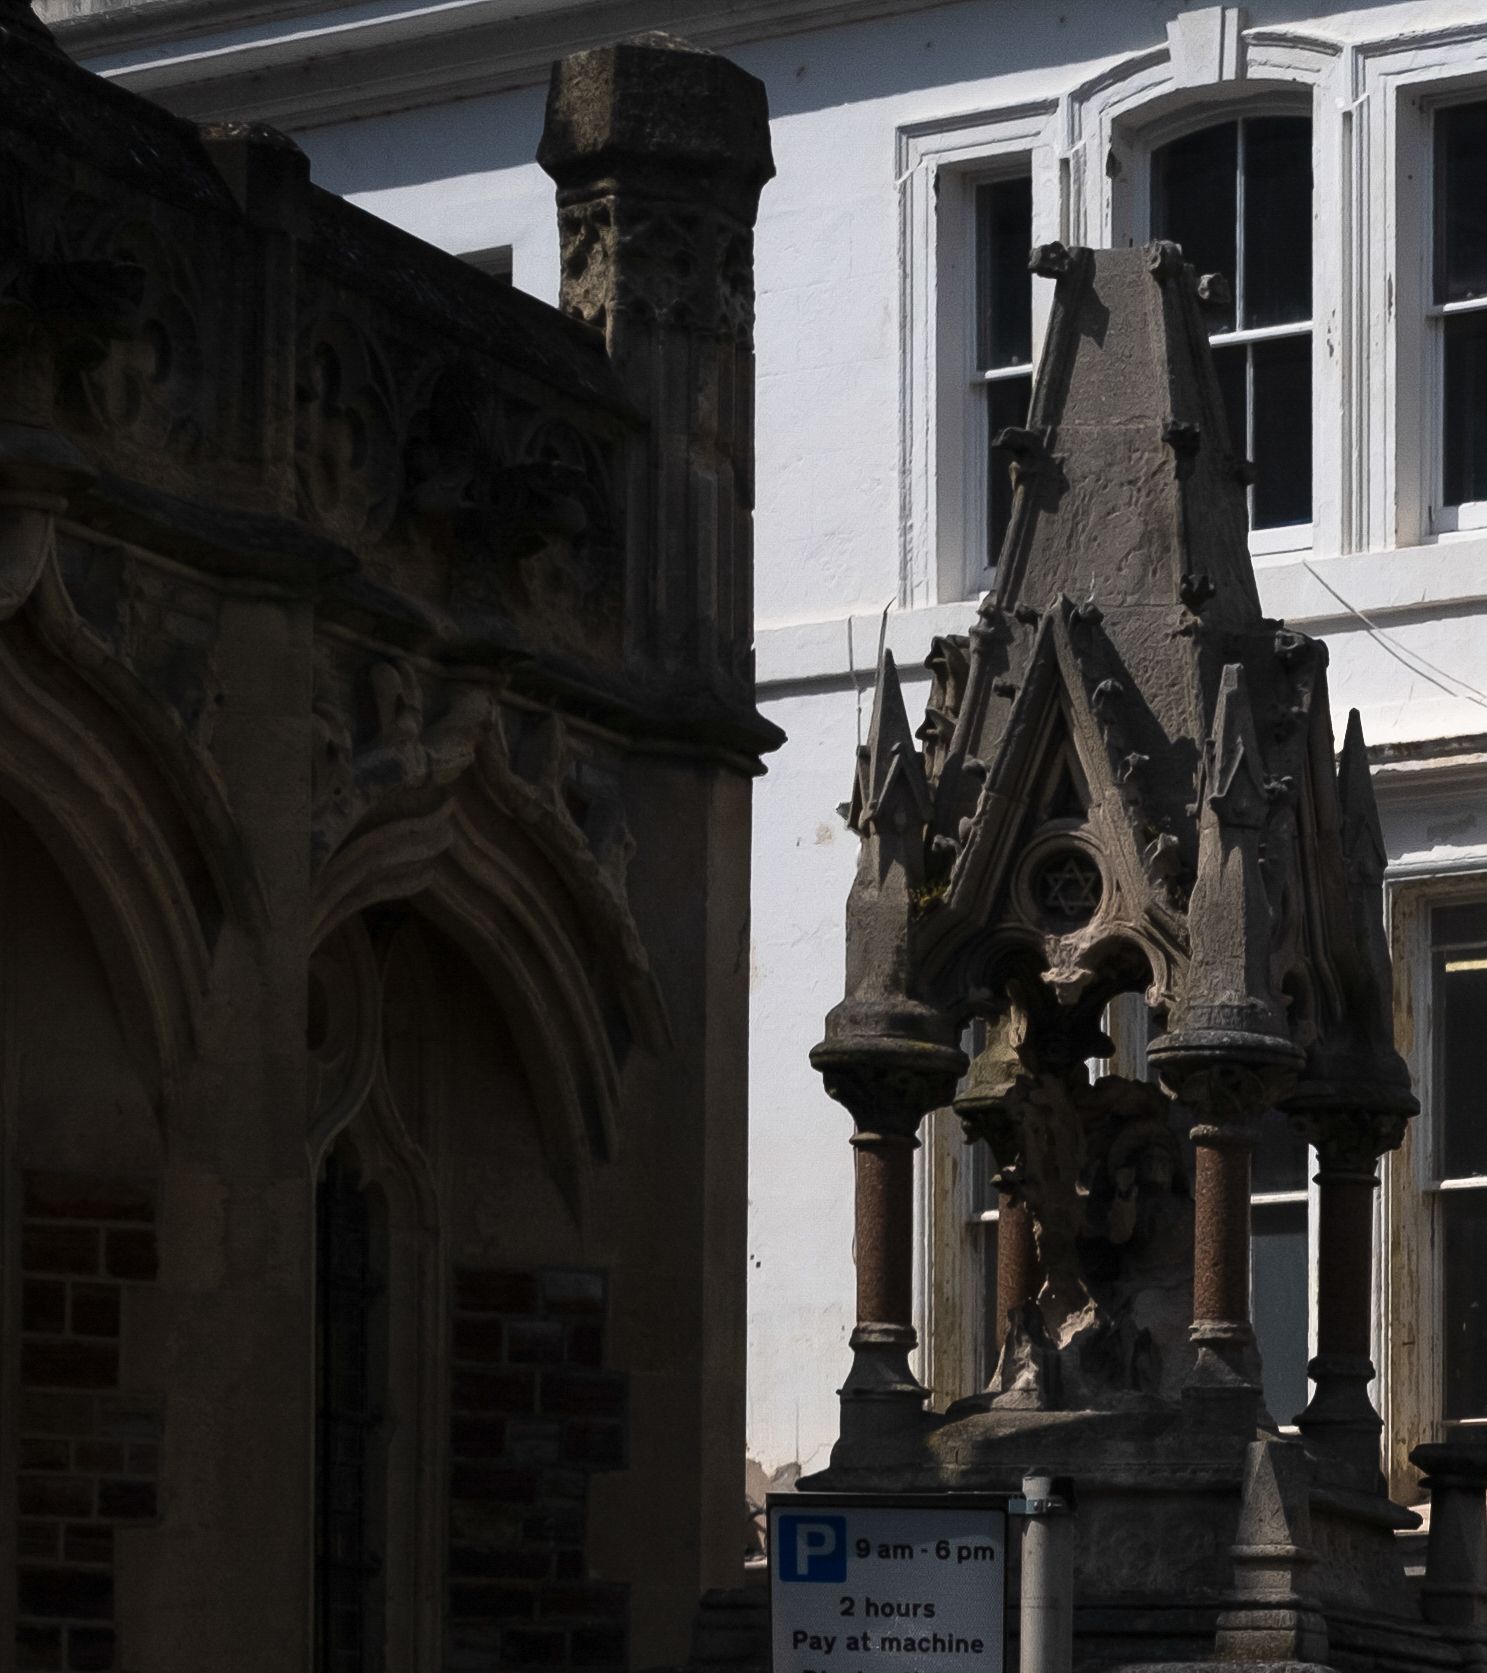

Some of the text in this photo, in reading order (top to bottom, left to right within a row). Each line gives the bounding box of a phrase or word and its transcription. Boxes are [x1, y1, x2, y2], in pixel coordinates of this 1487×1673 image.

[855, 1539, 871, 1561] 9
[875, 1543, 914, 1562] am
[935, 1539, 951, 1561] 6
[956, 1543, 996, 1565] pm
[840, 1596, 936, 1619] 2 hours
[792, 1631, 985, 1654] Pay at machine
